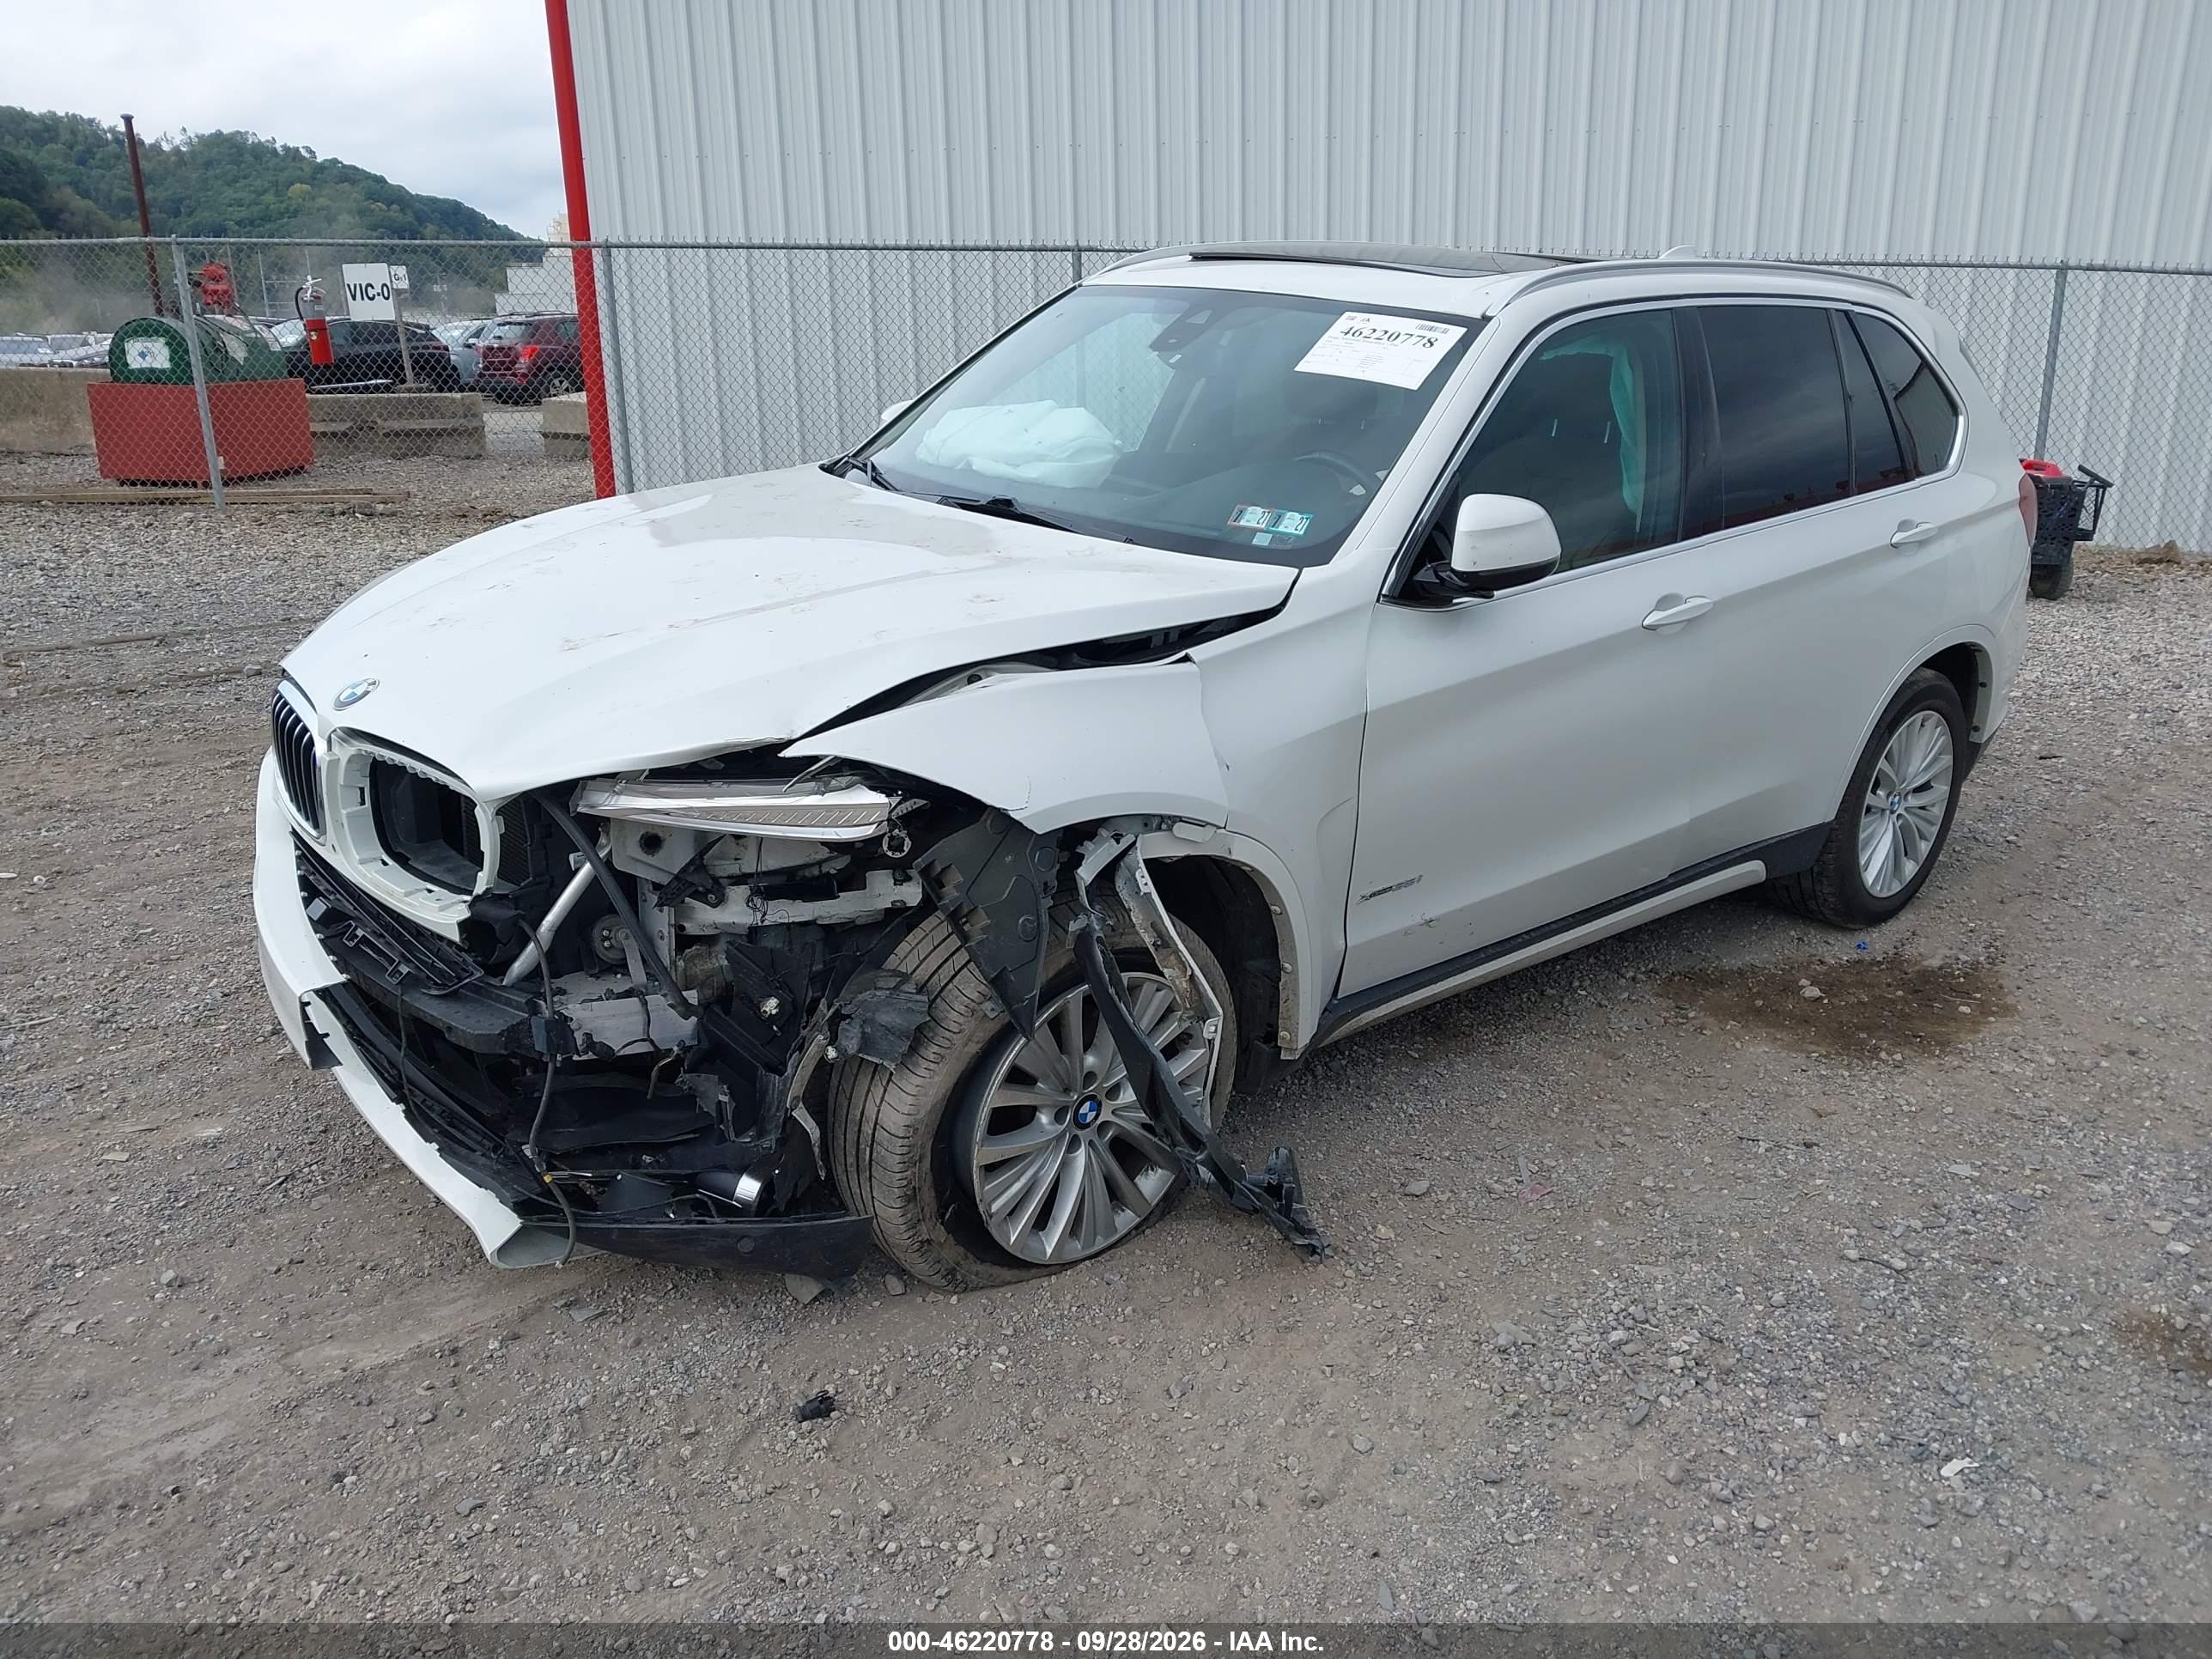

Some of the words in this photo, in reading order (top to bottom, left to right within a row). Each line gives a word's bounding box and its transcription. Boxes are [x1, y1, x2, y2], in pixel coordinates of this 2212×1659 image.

[346, 283, 391, 301] VIC-0
[1340, 325, 1438, 349] 46220778
[1256, 510, 1271, 526] 27
[1294, 516, 1310, 532] 27
